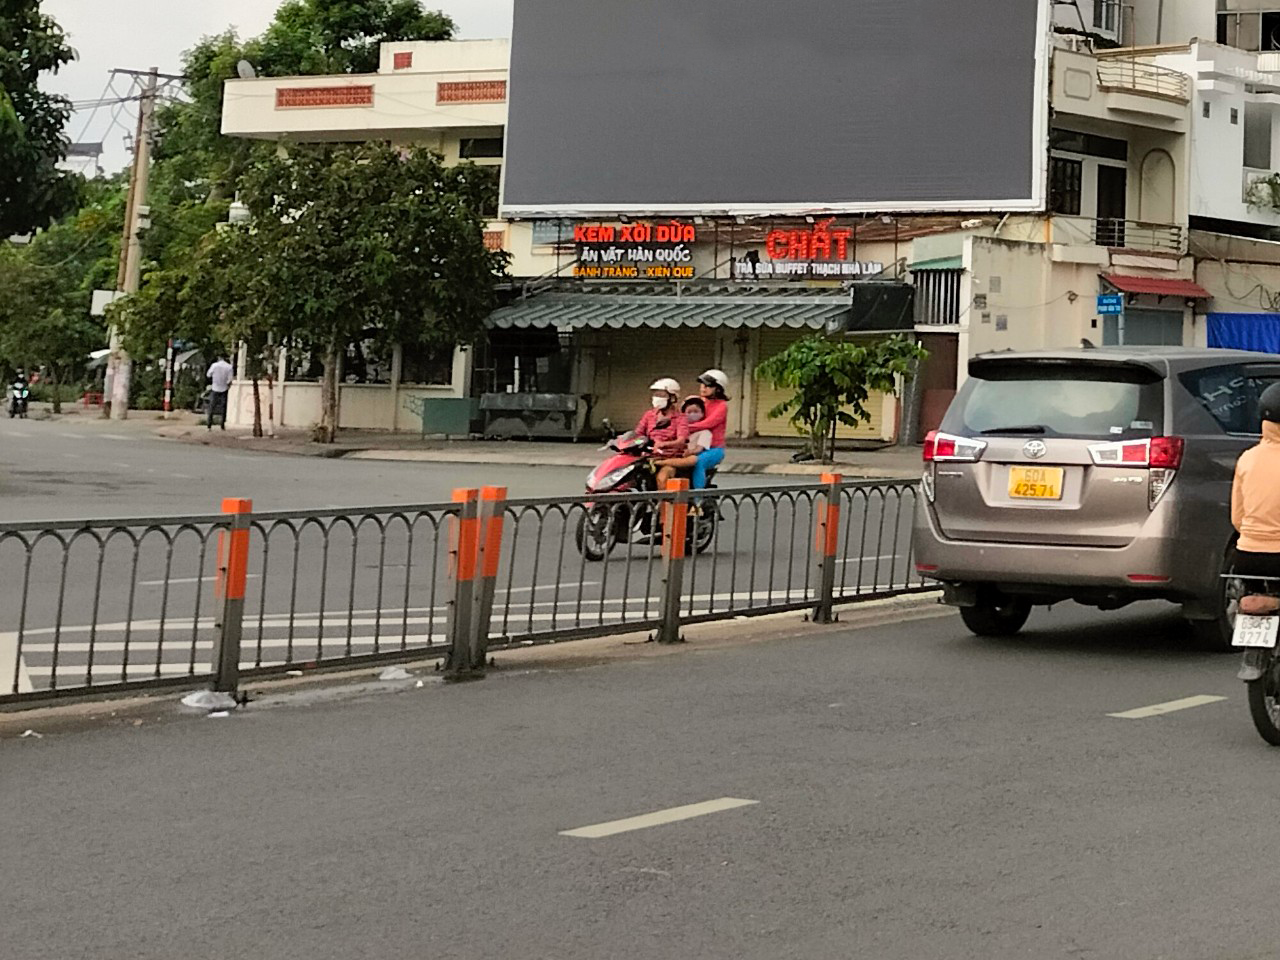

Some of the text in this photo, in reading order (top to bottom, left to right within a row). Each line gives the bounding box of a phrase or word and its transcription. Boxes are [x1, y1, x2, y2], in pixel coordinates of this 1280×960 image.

[574, 224, 614, 243] KEM
[656, 220, 695, 243] DỪA
[765, 217, 852, 260] CHẤT
[601, 246, 625, 264] VẶT
[628, 246, 653, 262] HÀN
[655, 244, 691, 262] QUỐC
[776, 263, 808, 274] BUFFET
[1024, 470, 1046, 483] 60A
